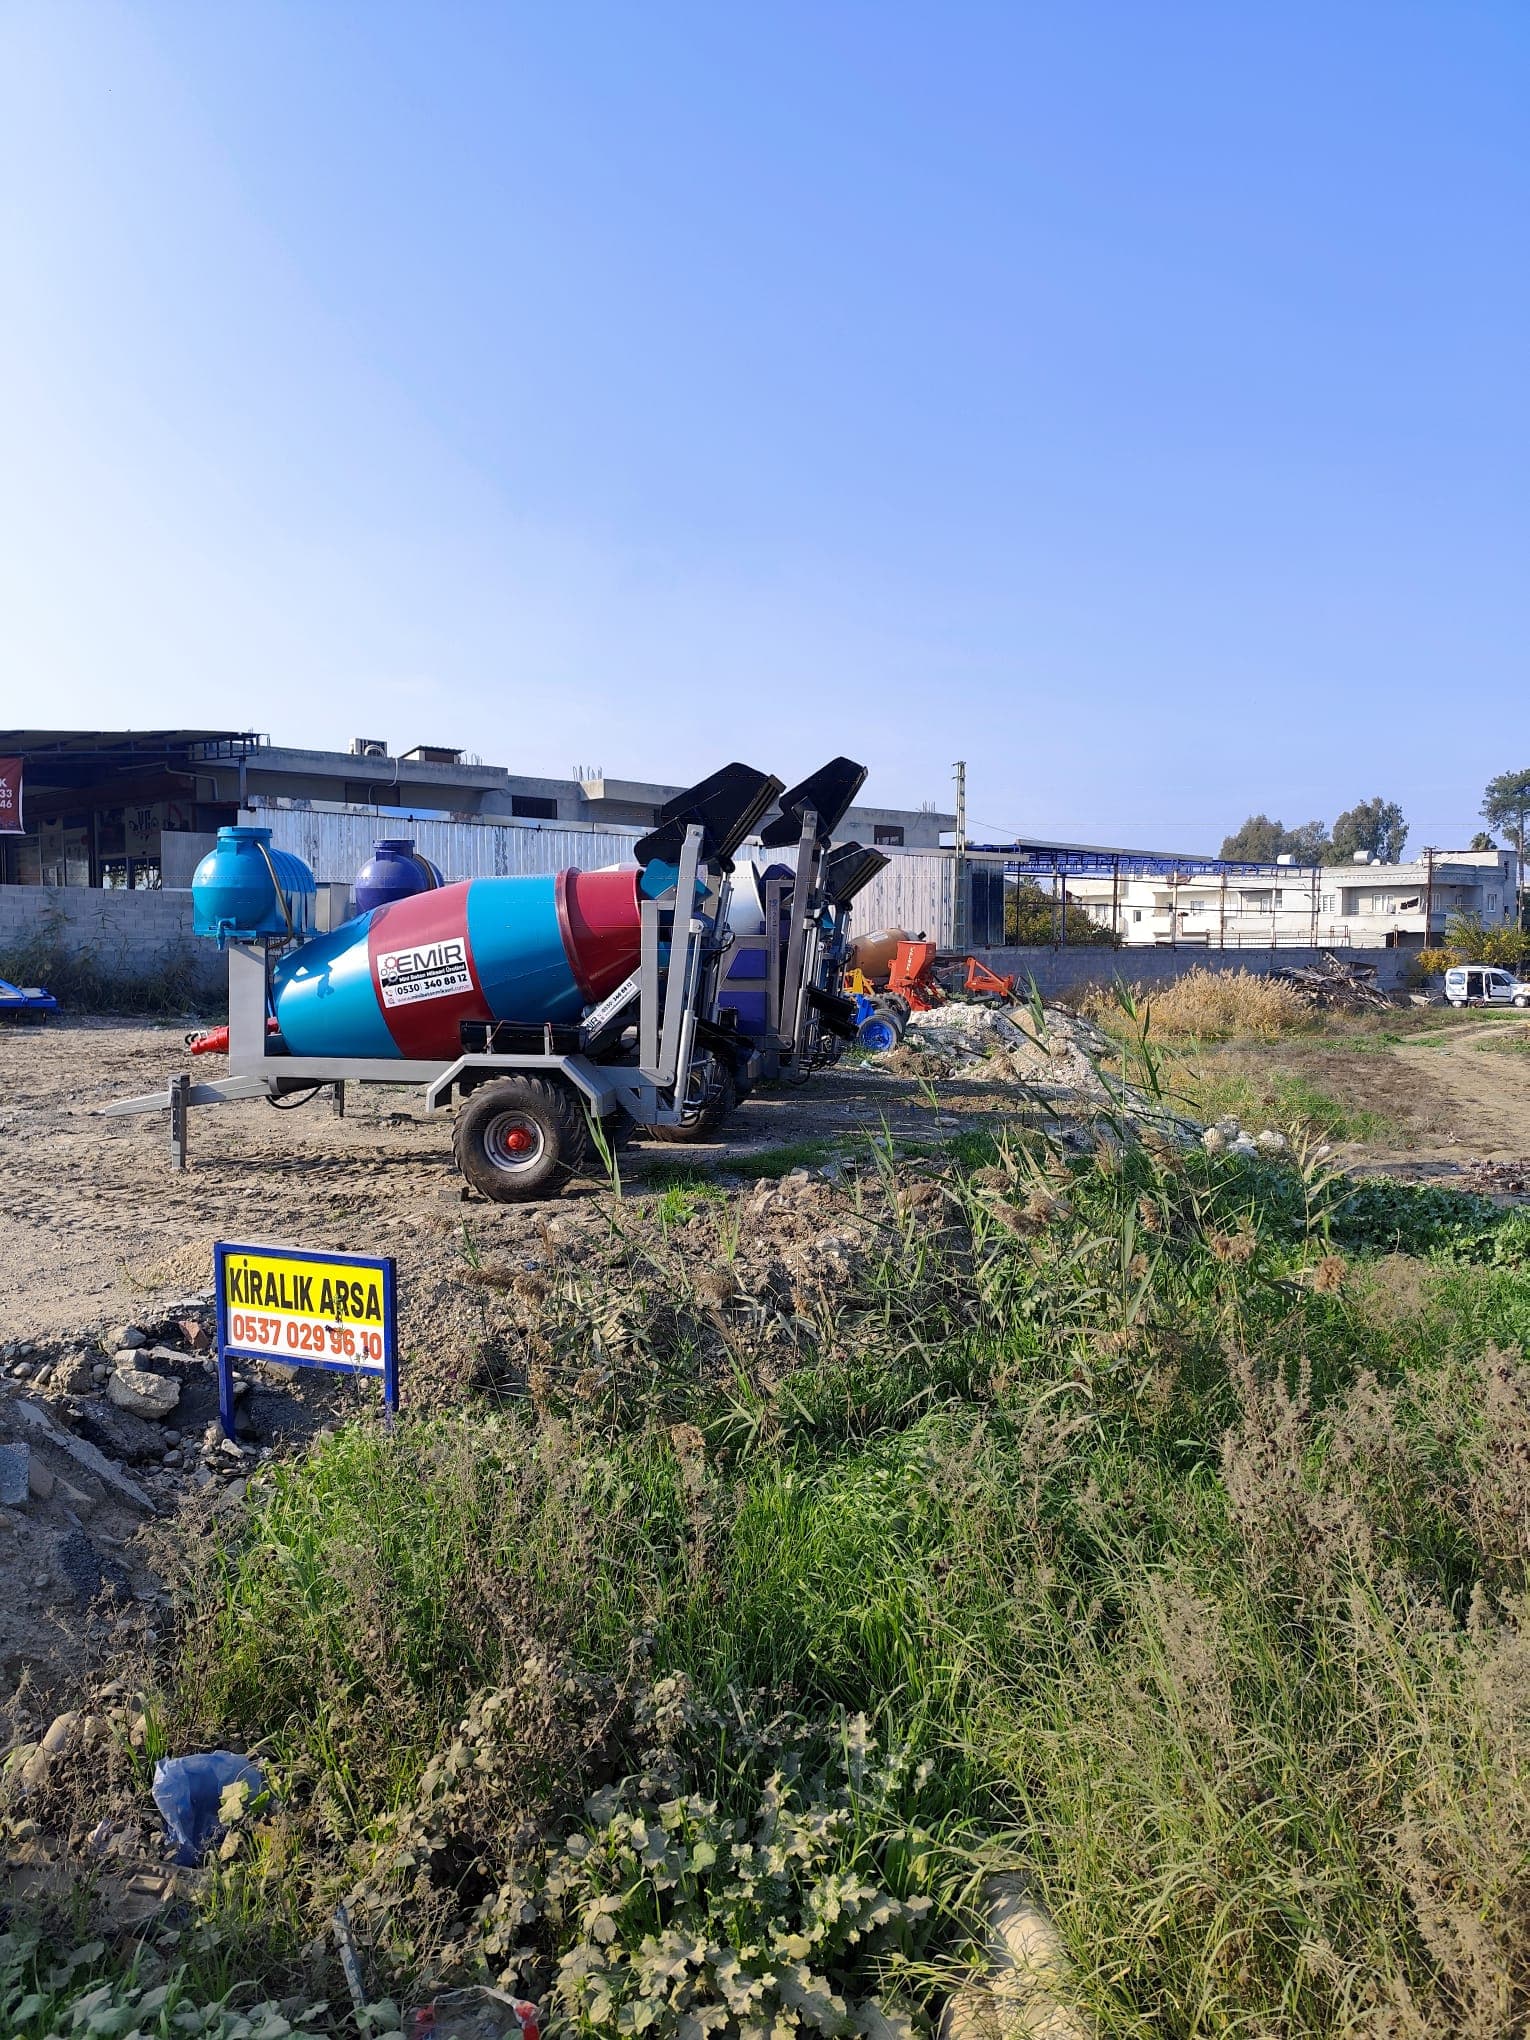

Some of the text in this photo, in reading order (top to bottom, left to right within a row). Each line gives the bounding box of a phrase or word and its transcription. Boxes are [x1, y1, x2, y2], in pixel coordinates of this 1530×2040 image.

[423, 979, 442, 990] 340
[444, 975, 456, 986] 88
[457, 973, 468, 982] 12
[229, 1258, 382, 1321] KİRALIK ARSA
[232, 1314, 382, 1361] 0537 029 96 10
